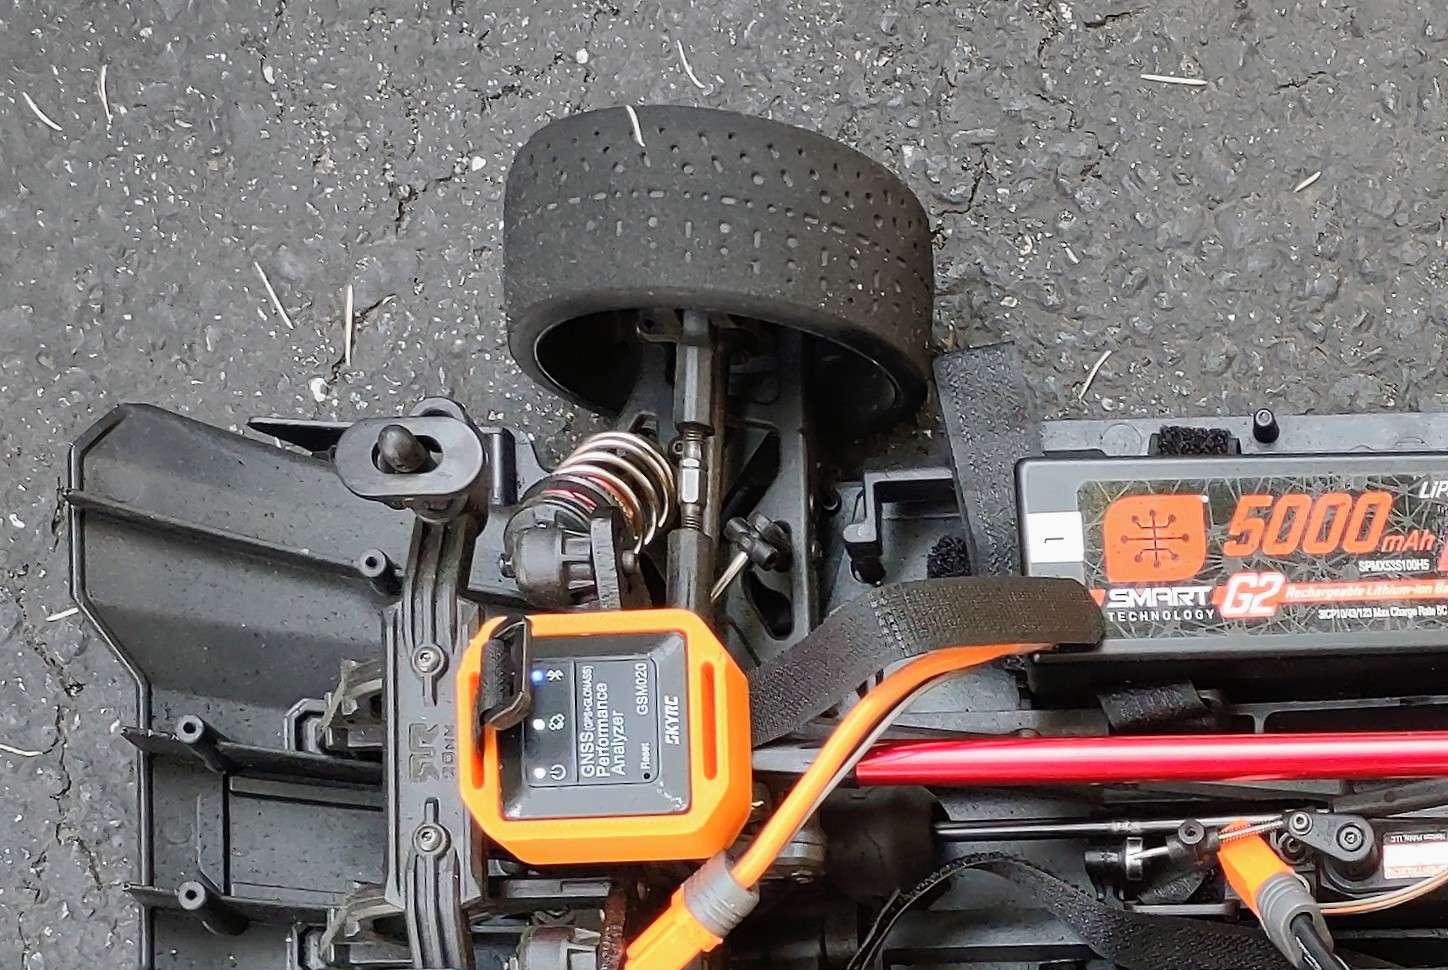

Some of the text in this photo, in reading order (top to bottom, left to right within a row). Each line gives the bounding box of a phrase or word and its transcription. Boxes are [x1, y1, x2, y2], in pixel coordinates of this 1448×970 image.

[1223, 490, 1436, 556] 5000 mAh
[1107, 571, 1285, 618] SMART G2
[1286, 583, 1366, 600] Rechargeable
[1374, 606, 1390, 618] Max
[1391, 606, 1417, 618] Charge
[1418, 605, 1435, 617] Rate
[1108, 609, 1215, 622] TECHNOLOGY
[635, 663, 649, 716] GSM020
[595, 683, 610, 777] Performance
[610, 711, 628, 775] Analyzer
[664, 695, 680, 746] SKYRC
[580, 732, 595, 778] GNSS
[640, 742, 651, 770] Reset
